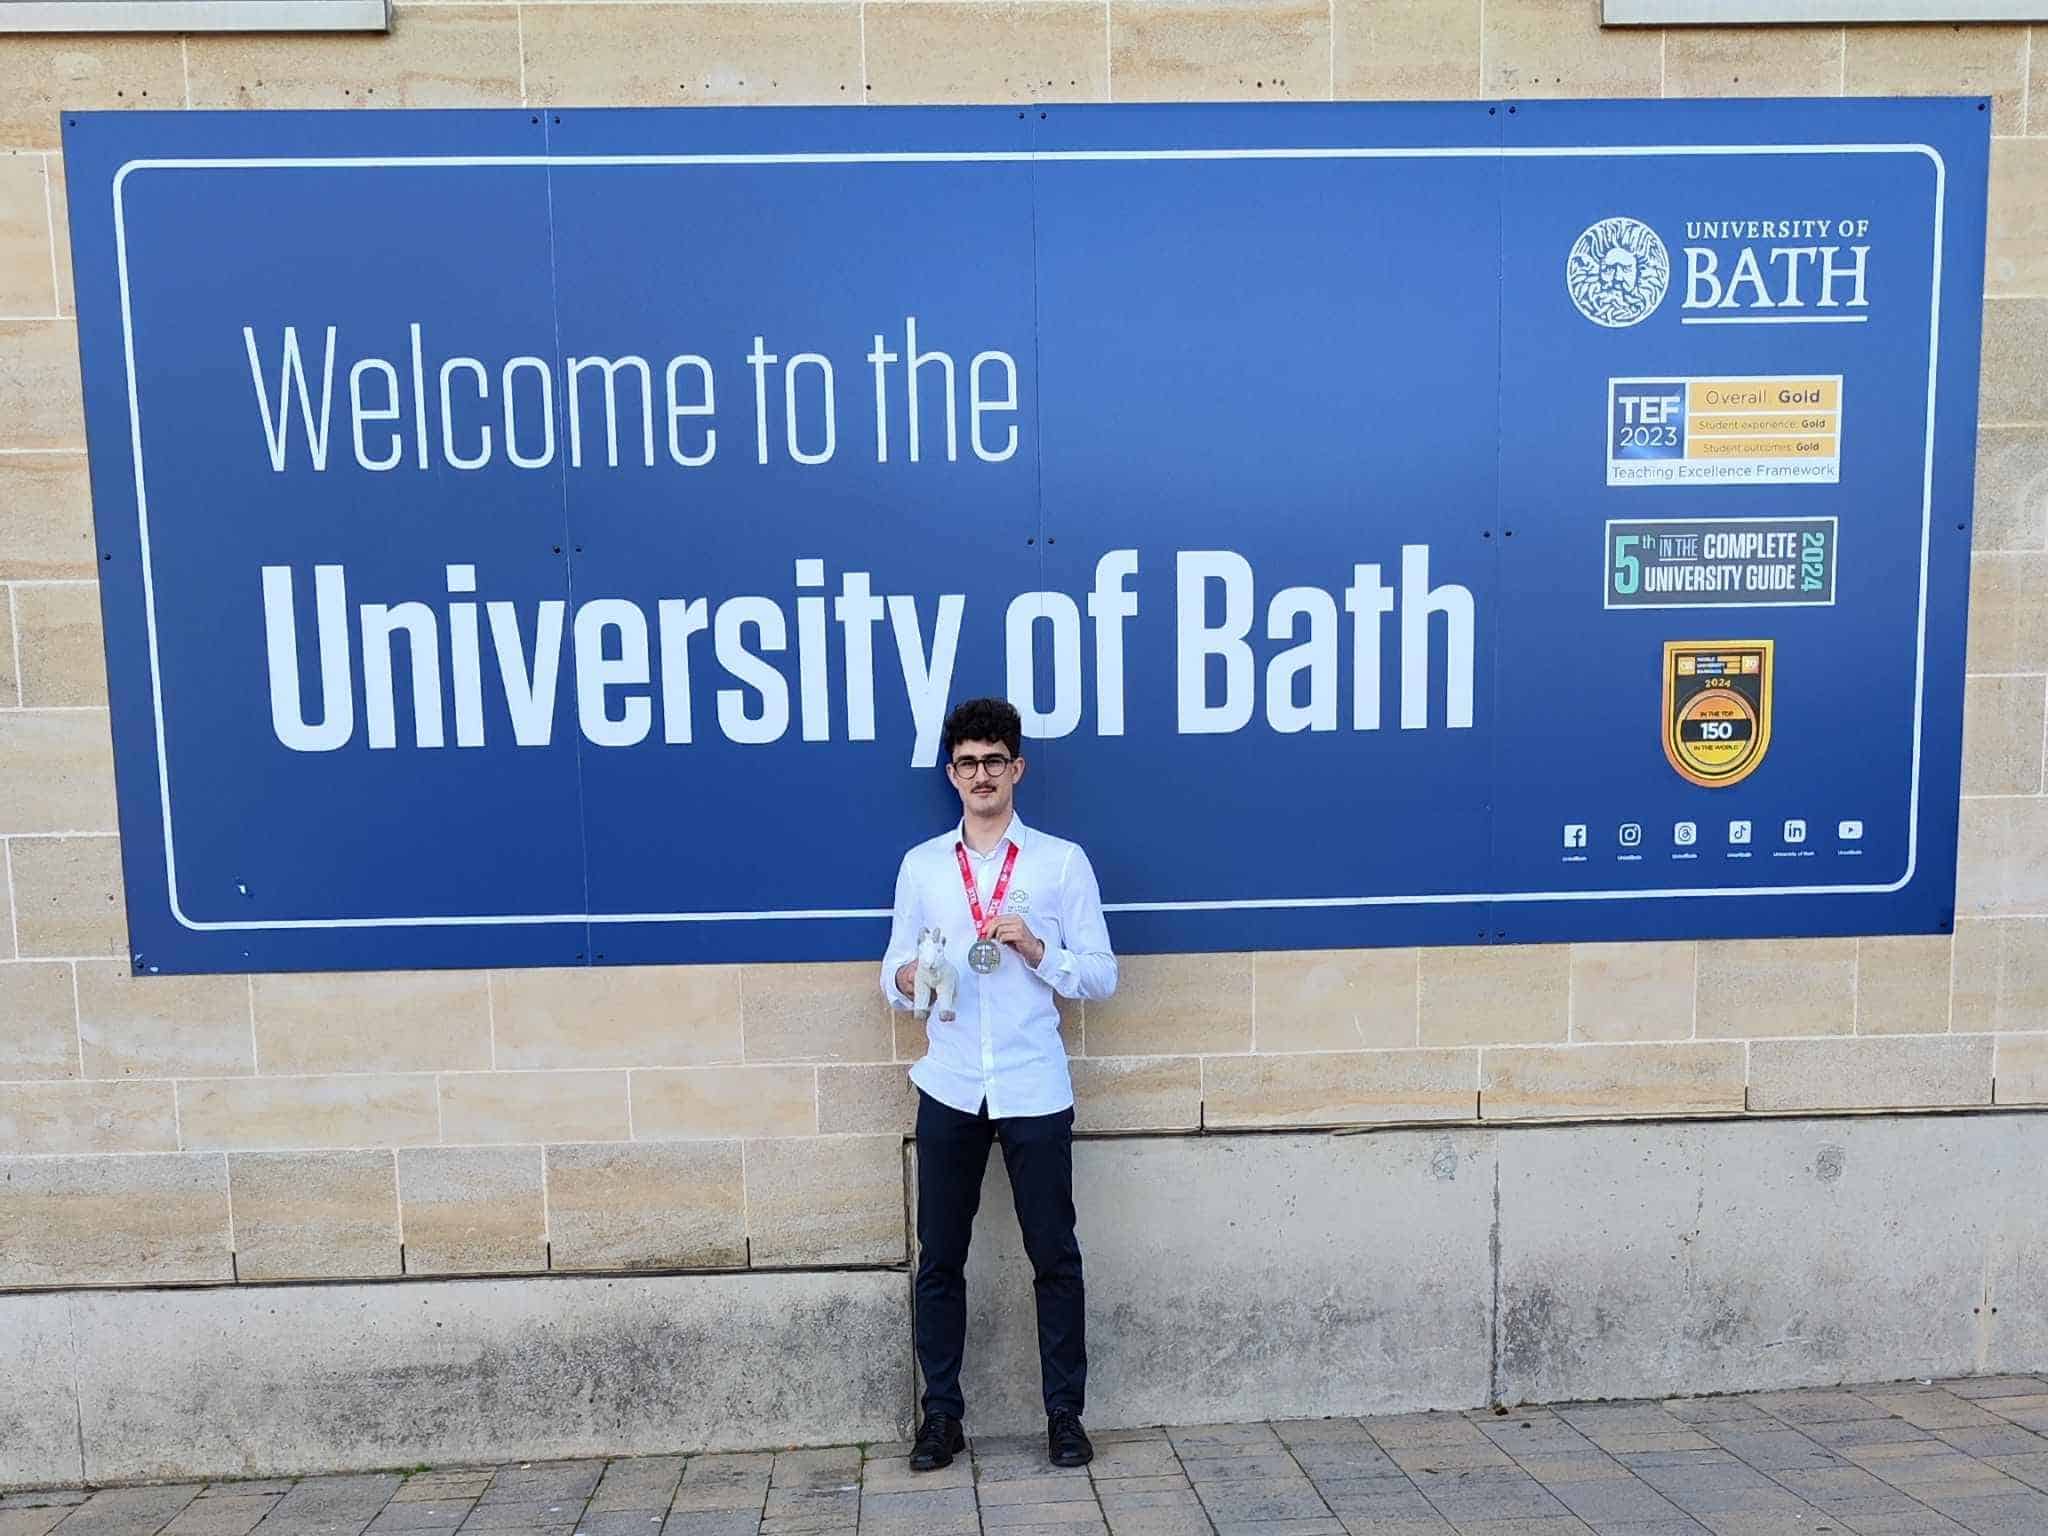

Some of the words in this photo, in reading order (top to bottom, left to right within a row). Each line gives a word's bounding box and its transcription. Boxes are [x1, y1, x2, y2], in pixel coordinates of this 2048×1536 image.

[1686, 220, 1831, 239] UNIVERSITY
[1838, 220, 1869, 237] OF
[1681, 246, 1871, 309] BATH
[243, 322, 716, 472] Welcome
[746, 336, 836, 465] to
[867, 316, 1018, 463] the
[1778, 389, 1821, 404] Gold
[1618, 395, 1681, 424] TEF
[1699, 420, 1739, 431] Student
[1801, 418, 1826, 429] Gold
[1619, 426, 1678, 447] 2023
[1703, 443, 1743, 453] Student
[1796, 441, 1819, 452] Gold
[1612, 466, 1674, 480] Teaching
[1679, 464, 1752, 478] Excellence
[1757, 463, 1835, 477] Framework
[1659, 538, 1674, 558] IN
[1675, 538, 1699, 558] THE
[1703, 532, 1798, 560] COMPLETE
[1801, 532, 1825, 592] 2024
[1644, 564, 1744, 593] UNIVERSITY
[1745, 564, 1797, 591] GUIDE
[261, 558, 966, 768] University
[1005, 549, 1139, 739] of
[1176, 544, 1475, 734] Bath
[1704, 678, 1731, 688] 2024
[1700, 721, 1733, 740] 150
